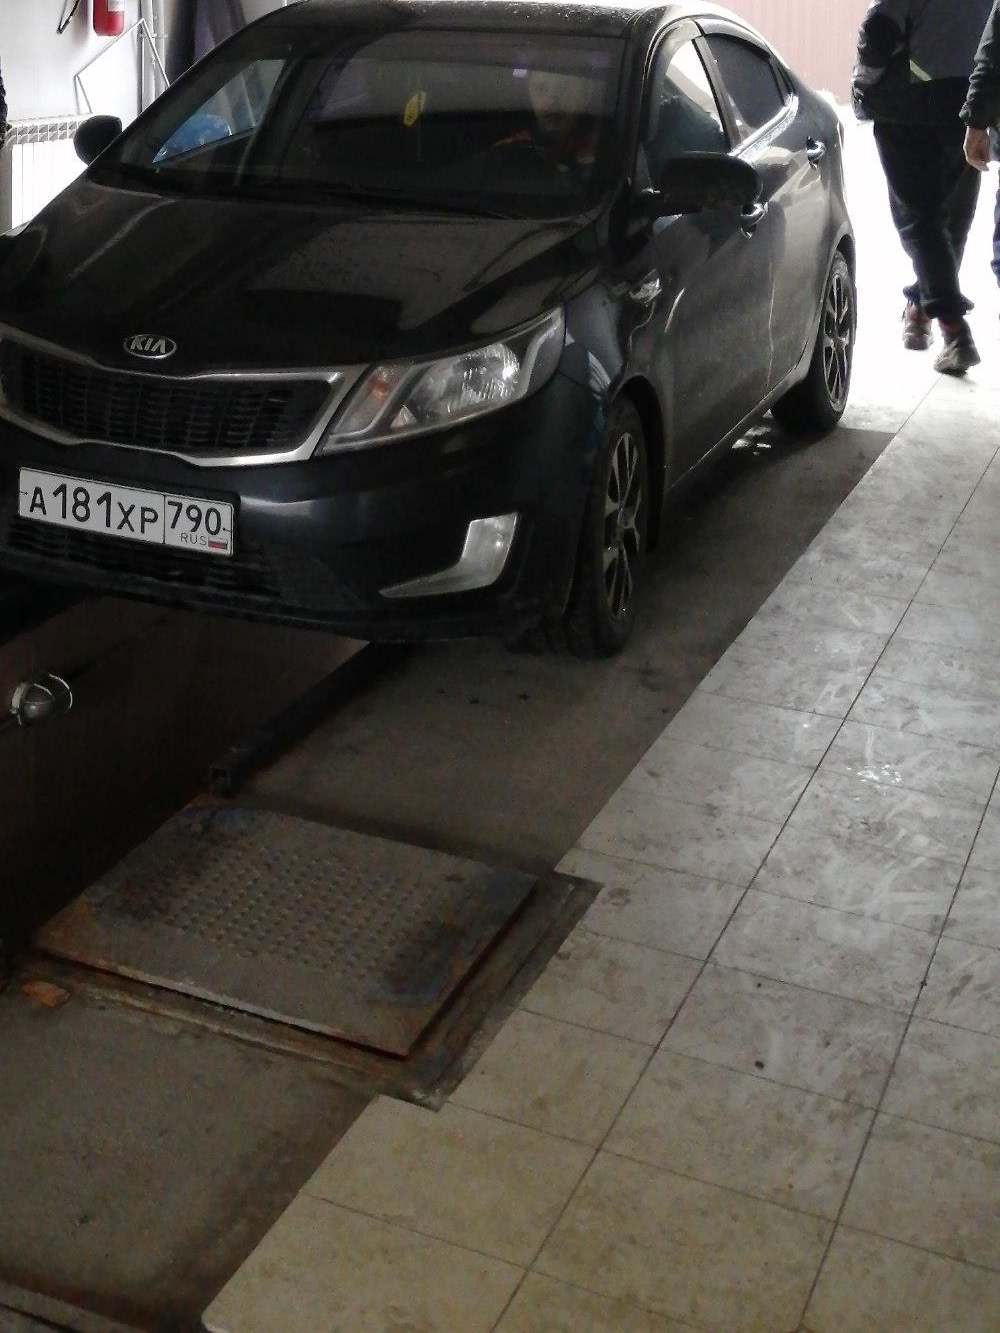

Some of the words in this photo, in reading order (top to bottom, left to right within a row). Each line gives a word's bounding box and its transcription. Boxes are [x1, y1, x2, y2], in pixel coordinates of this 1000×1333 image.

[130, 337, 166, 354] KIA
[29, 483, 159, 534] А181ХР
[167, 500, 222, 536] 790
[180, 532, 207, 546] RUS
